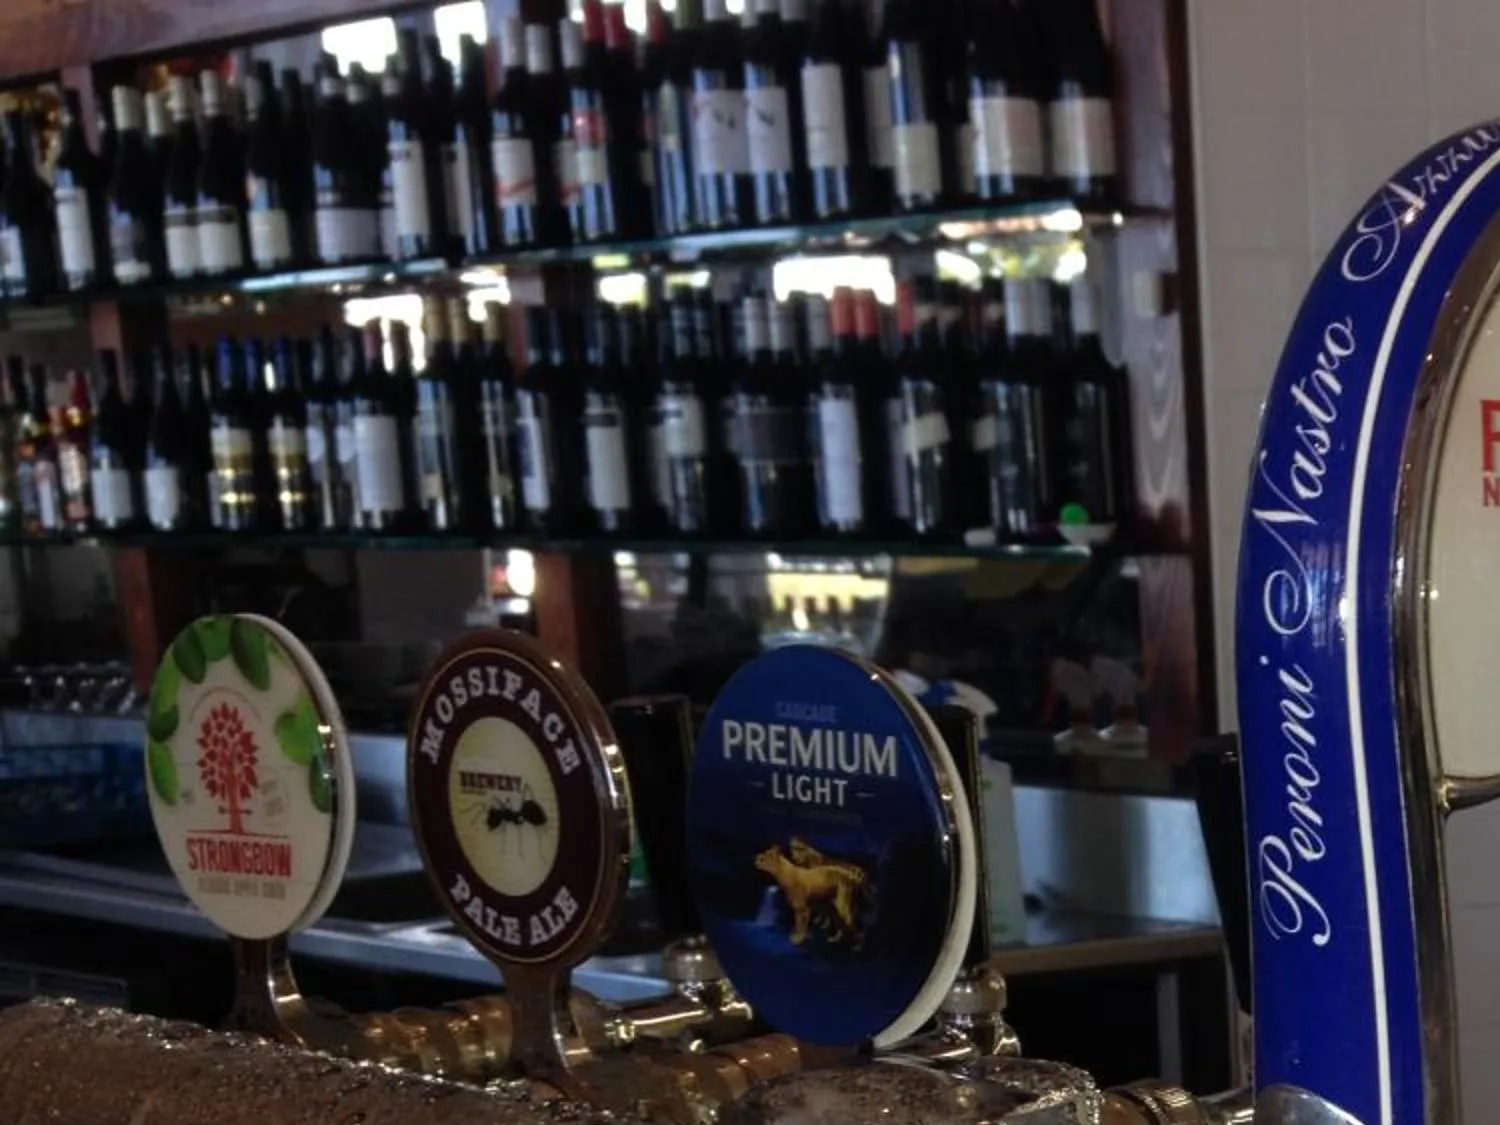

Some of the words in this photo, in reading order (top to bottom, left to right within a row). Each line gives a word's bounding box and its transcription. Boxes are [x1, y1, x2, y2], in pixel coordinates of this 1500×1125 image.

[1252, 315, 1354, 636] Nastro
[420, 664, 581, 778] MOSSIFACE
[722, 719, 898, 777] PREMIUM
[771, 773, 849, 807] LIGHT
[1259, 654, 1331, 947] Peroni
[186, 837, 292, 878] STRONGBOW
[450, 873, 523, 946] PALE
[529, 885, 580, 947] ALE
